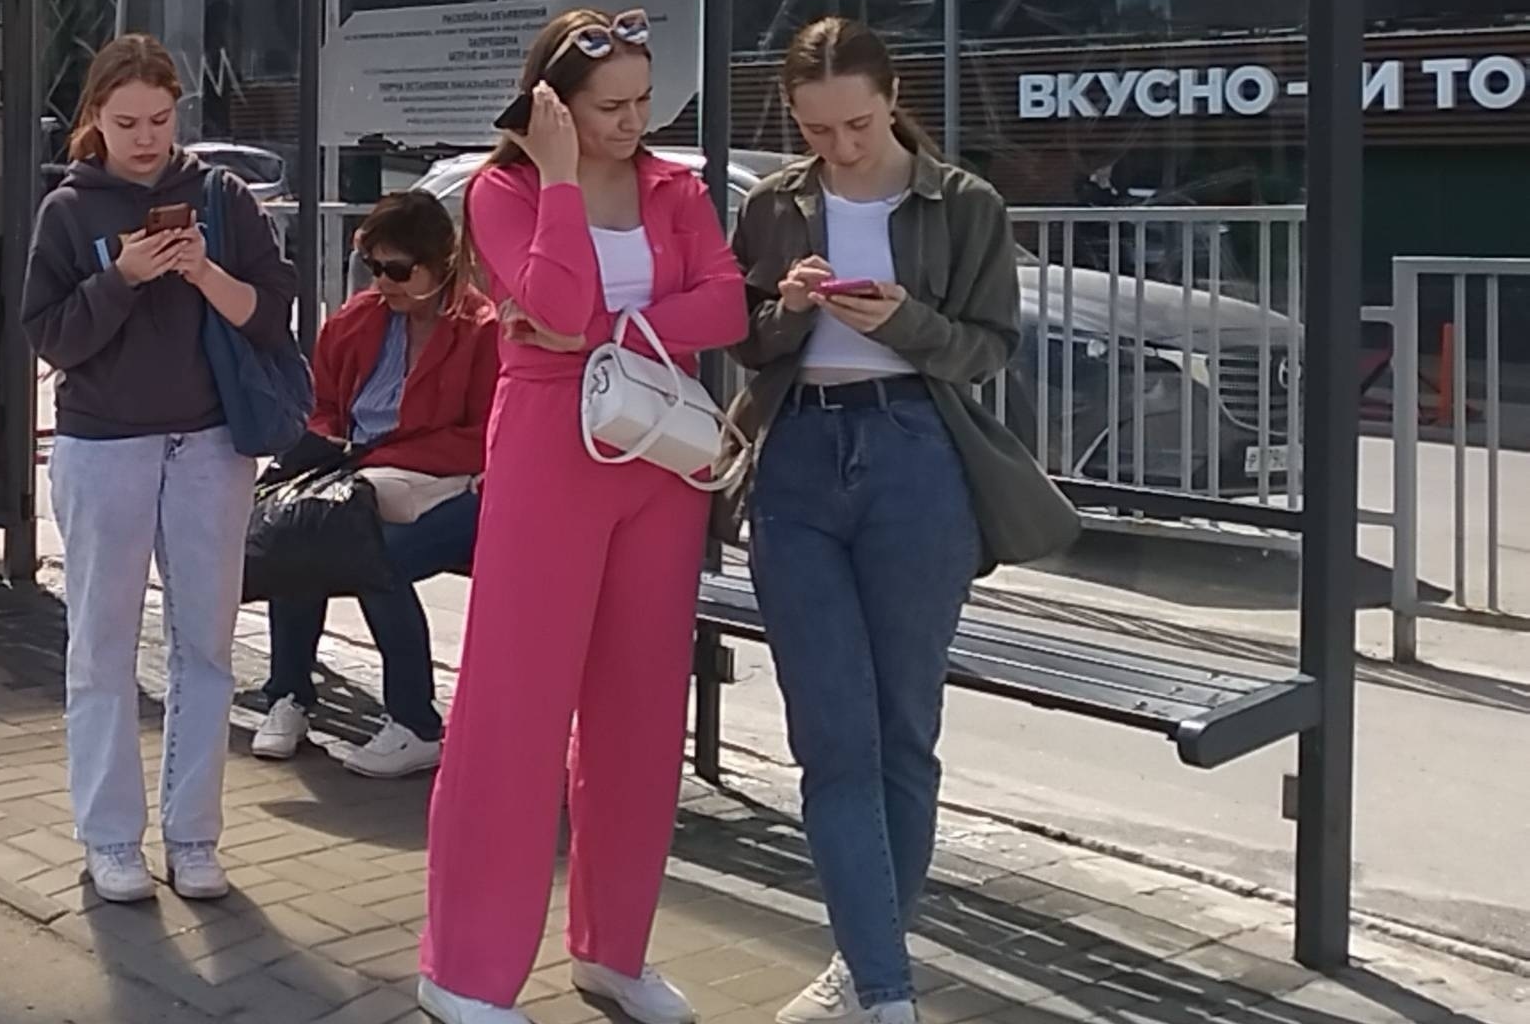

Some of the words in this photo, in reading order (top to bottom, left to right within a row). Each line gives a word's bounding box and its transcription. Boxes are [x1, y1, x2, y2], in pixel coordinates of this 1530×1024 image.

[1019, 65, 1278, 119] ВКУСНО
[1362, 59, 1404, 112] И
[1422, 55, 1530, 110] ТО
